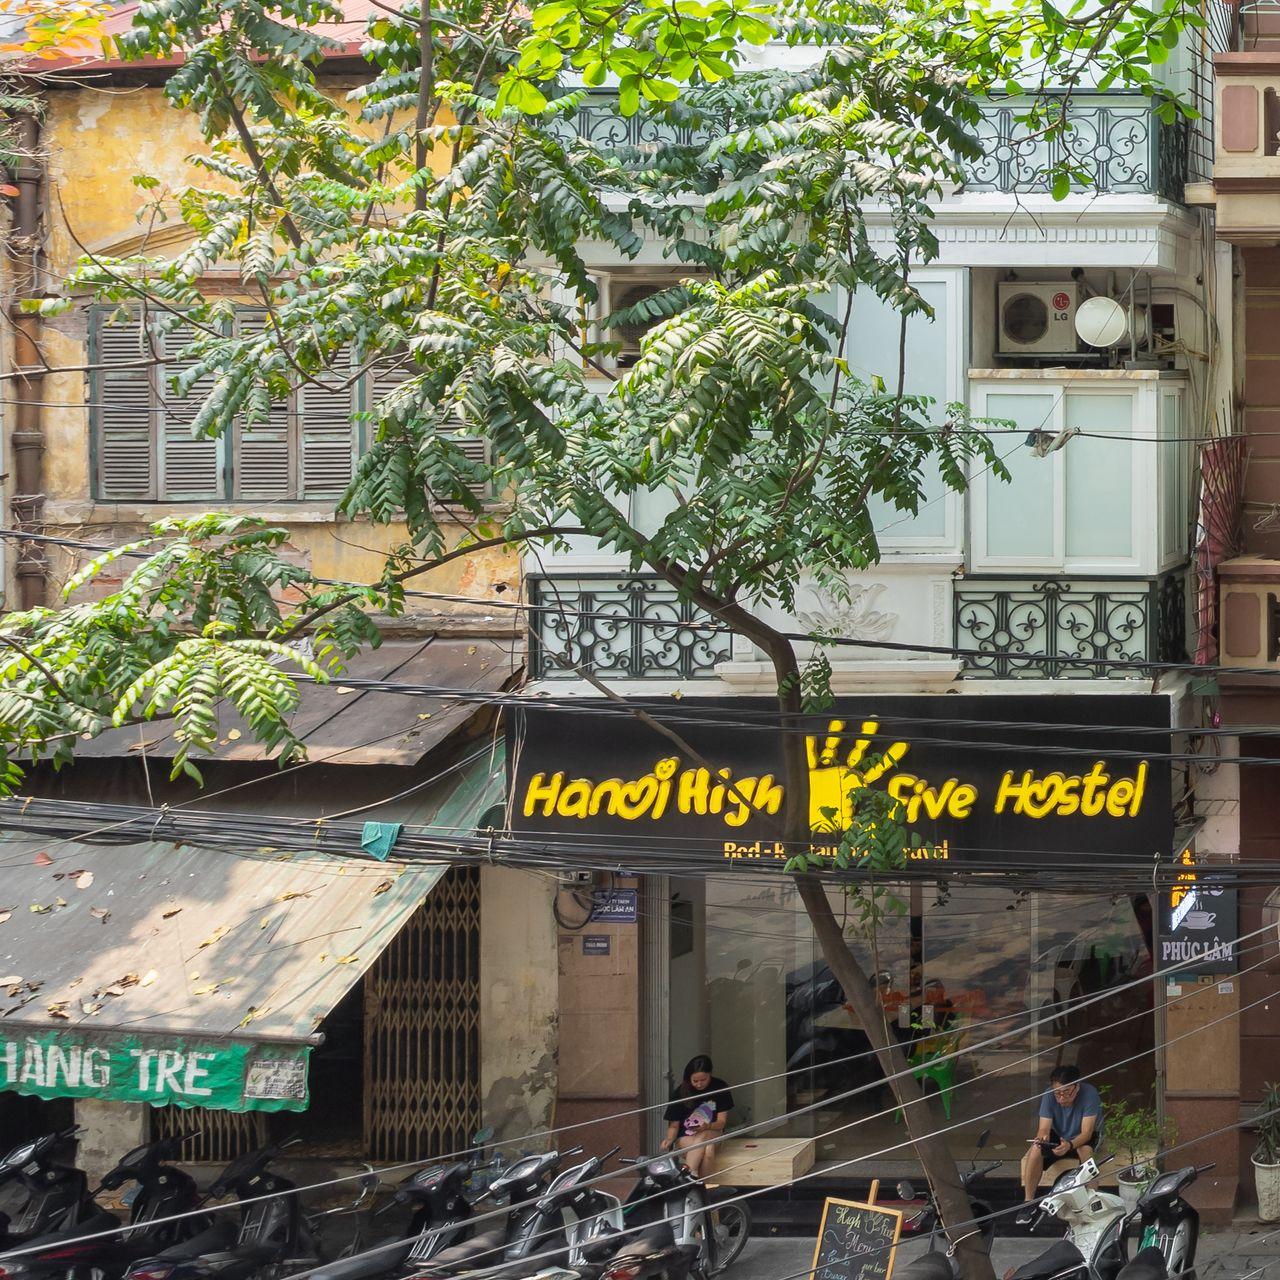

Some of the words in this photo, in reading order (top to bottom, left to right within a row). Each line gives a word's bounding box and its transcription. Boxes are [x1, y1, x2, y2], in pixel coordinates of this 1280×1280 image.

[1054, 313, 1068, 321] LG
[677, 766, 785, 827] High
[887, 773, 978, 823] Five
[994, 760, 1149, 819] Hostel
[1162, 936, 1200, 961] PHÚC
[1204, 936, 1233, 962] LÂM
[130, 1048, 216, 1097] TRE
